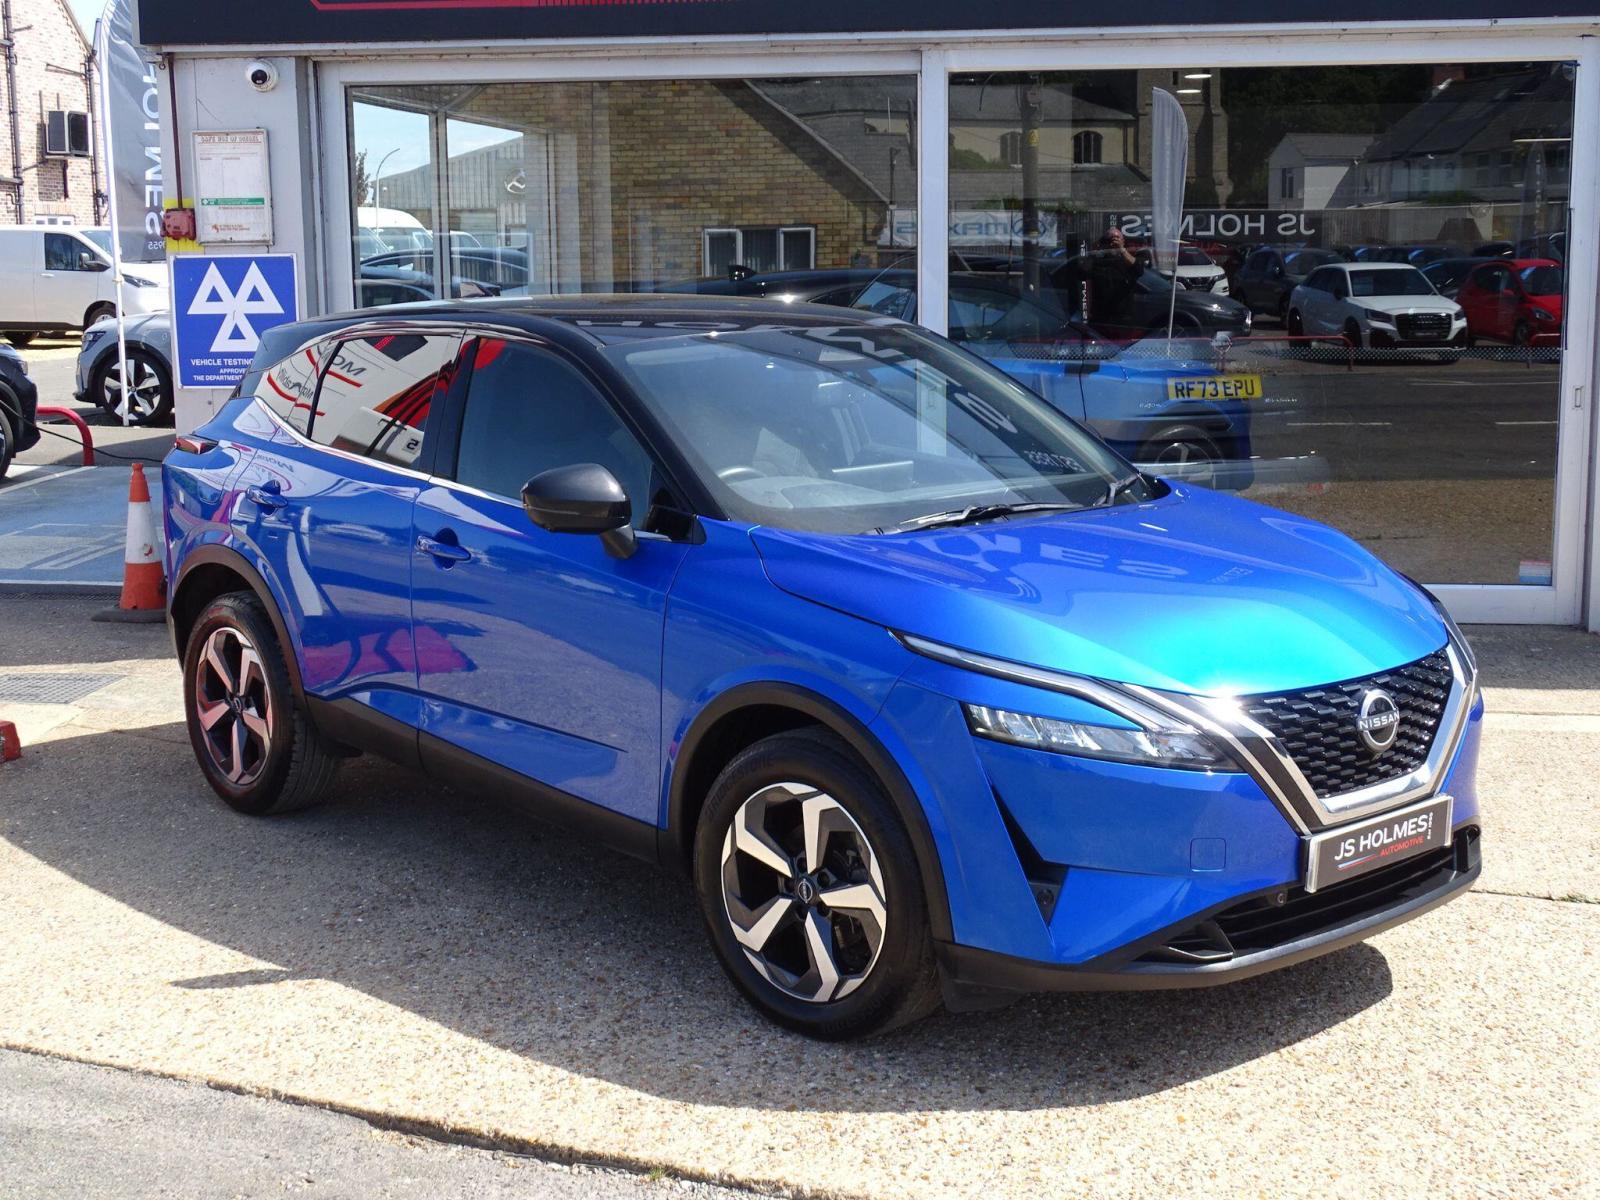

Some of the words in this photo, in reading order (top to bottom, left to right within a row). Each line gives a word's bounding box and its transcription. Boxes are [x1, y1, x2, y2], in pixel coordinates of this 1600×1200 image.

[190, 358, 222, 366] VEHICLE
[1174, 380, 1219, 399] RF73
[1223, 379, 1255, 398] EPU
[1359, 710, 1400, 730] NISSAN
[1334, 838, 1356, 861] JS
[1359, 814, 1429, 852] HOLMES
[1380, 835, 1425, 857] AUTOMOTIVE
